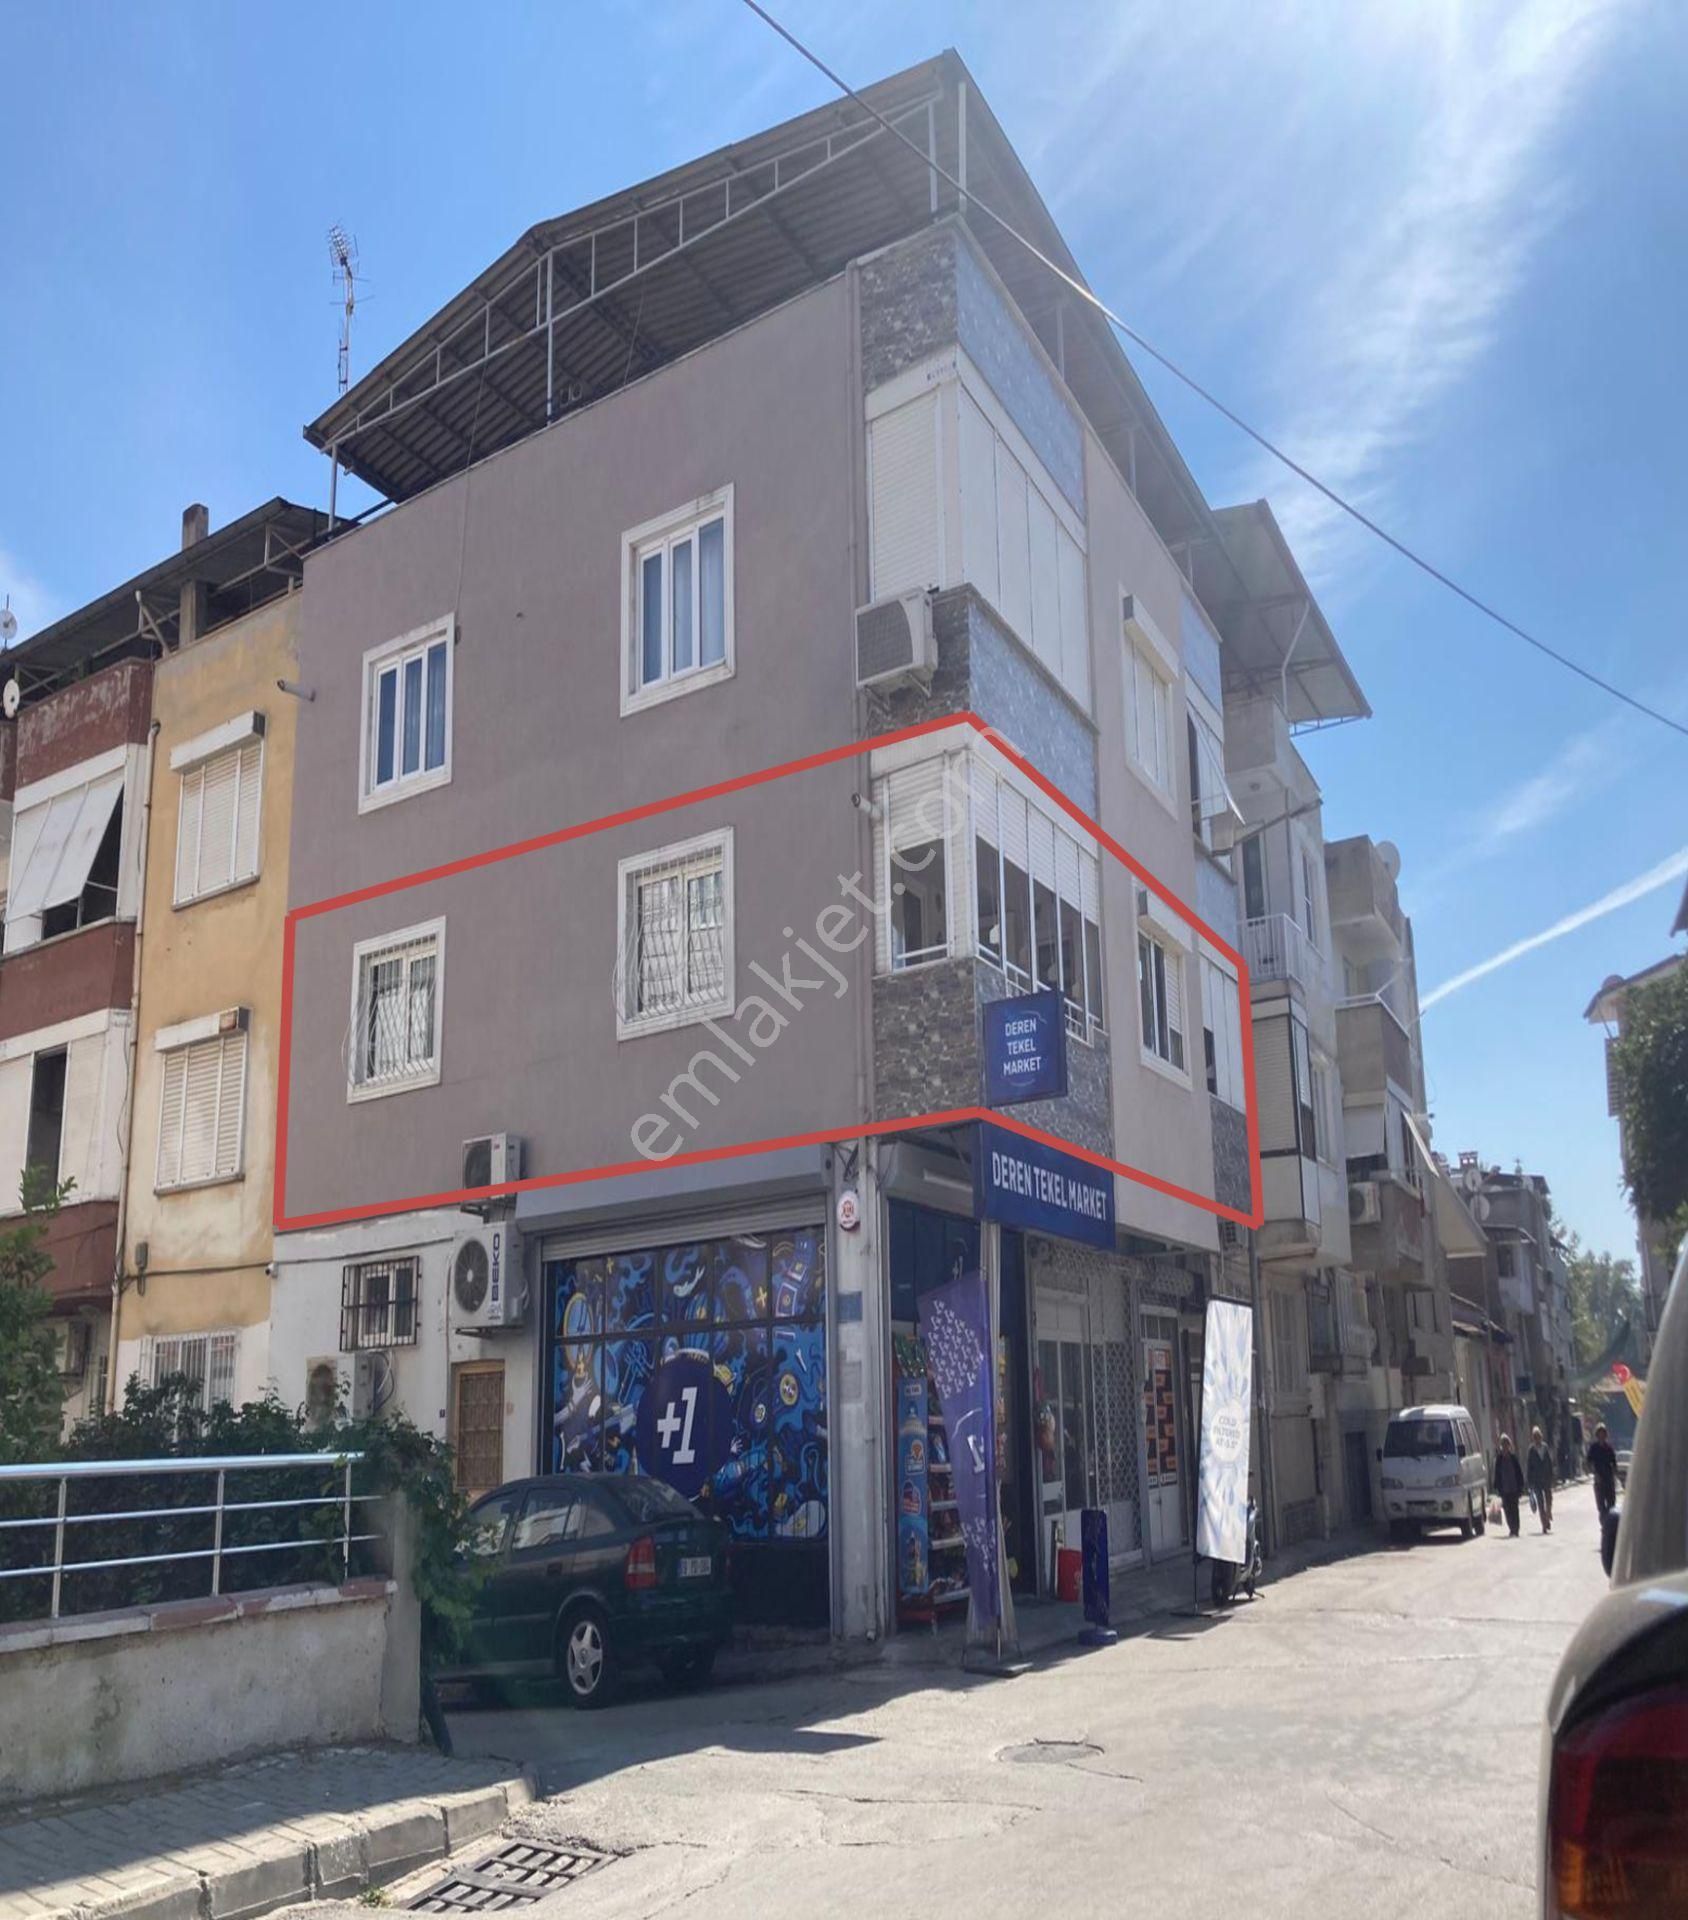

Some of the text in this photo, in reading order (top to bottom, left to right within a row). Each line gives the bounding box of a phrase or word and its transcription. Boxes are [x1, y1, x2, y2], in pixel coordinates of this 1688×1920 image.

[1004, 1018, 1037, 1037] DEREN
[1006, 1038, 1036, 1056] TEKEL
[1003, 1056, 1042, 1077] MARKET
[991, 1151, 1106, 1221] DEREN TEKEL MARKET
[657, 1386, 698, 1465] +1
